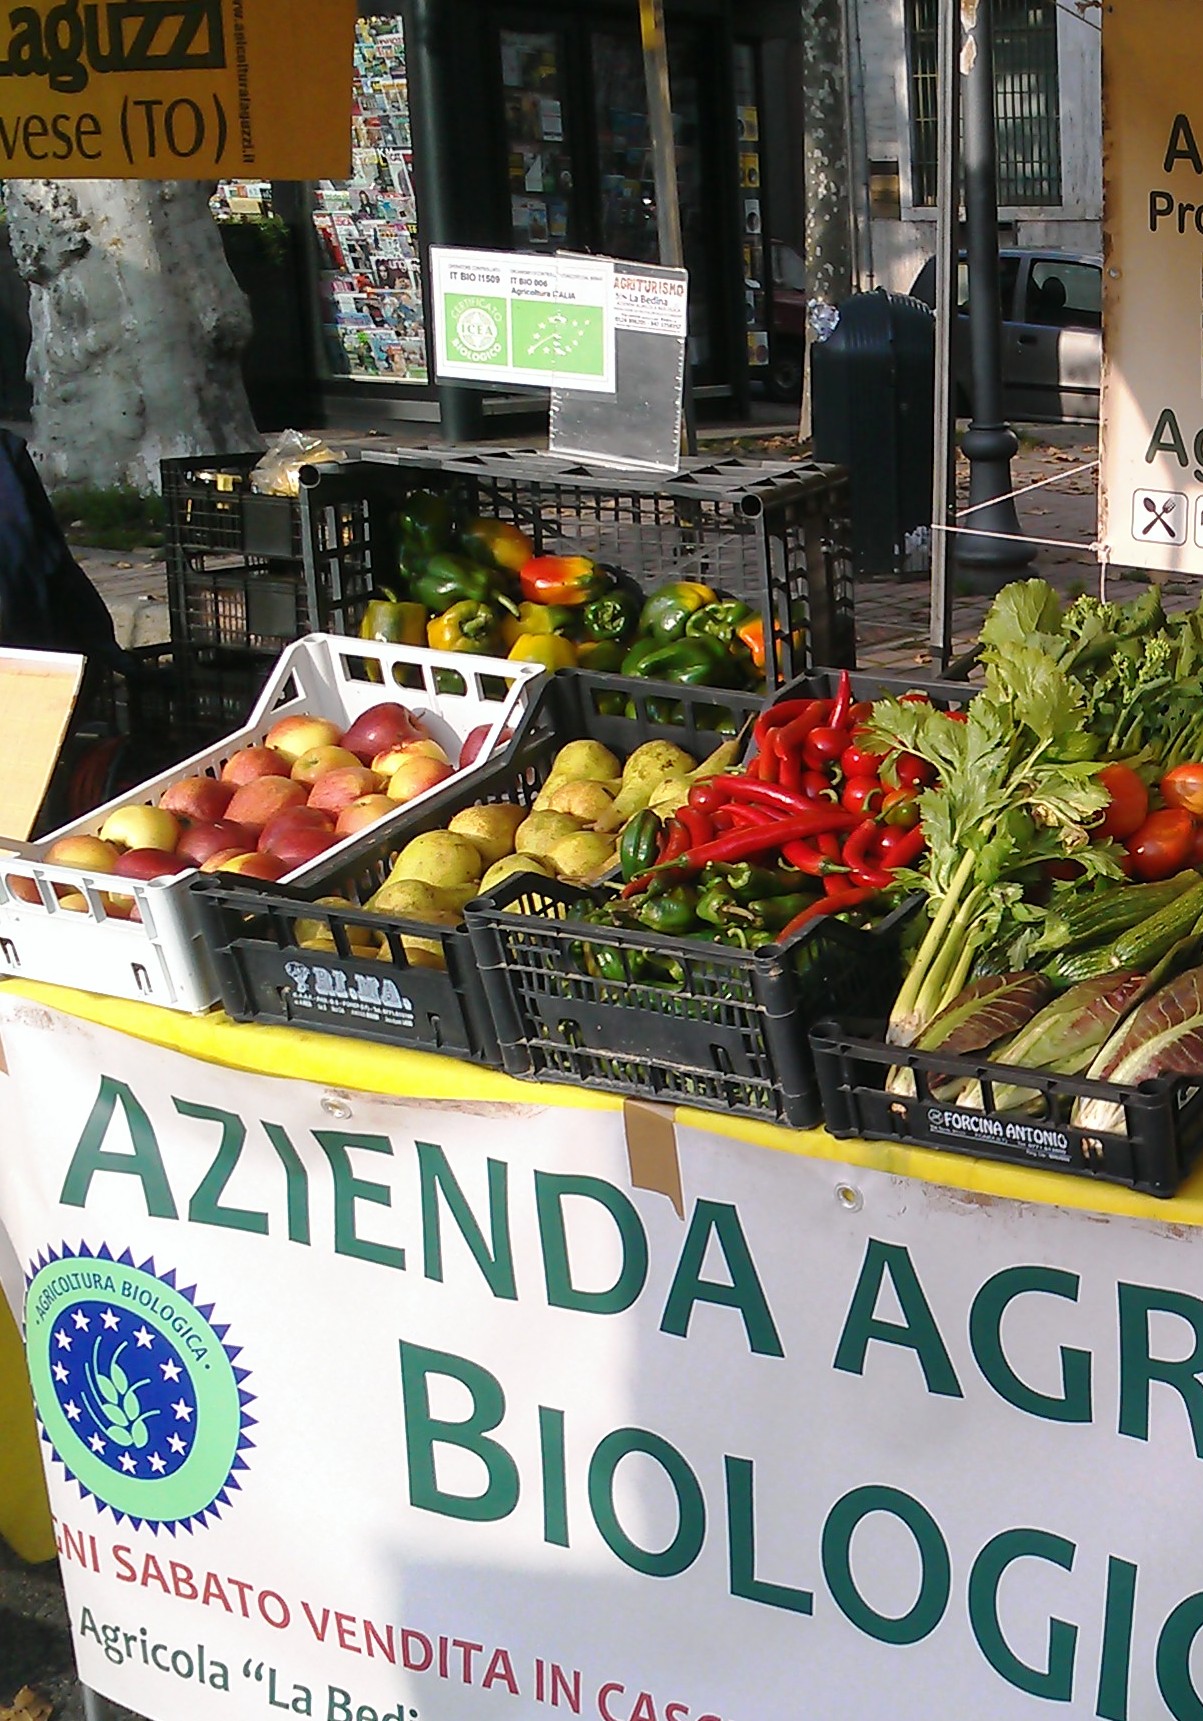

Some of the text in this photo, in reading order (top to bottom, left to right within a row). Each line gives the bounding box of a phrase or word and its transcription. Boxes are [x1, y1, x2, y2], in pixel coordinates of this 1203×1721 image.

[0, 0, 226, 93] aguzzi
[120, 93, 227, 164] (TO)
[613, 276, 685, 297] AGRITURISMO
[461, 324, 493, 336] ICEA
[943, 1111, 1004, 1137] FORCINA
[1005, 1122, 1068, 1150] ANTONIO
[58, 1074, 785, 1359] AZIENDA
[37, 1272, 209, 1362] AGRICOLTURA BIOLOGICA
[80, 1606, 230, 1692] Agricola
[112, 1544, 291, 1630] SABATO
[300, 1600, 520, 1696] VENDITA
[535, 1658, 581, 1714] IN
